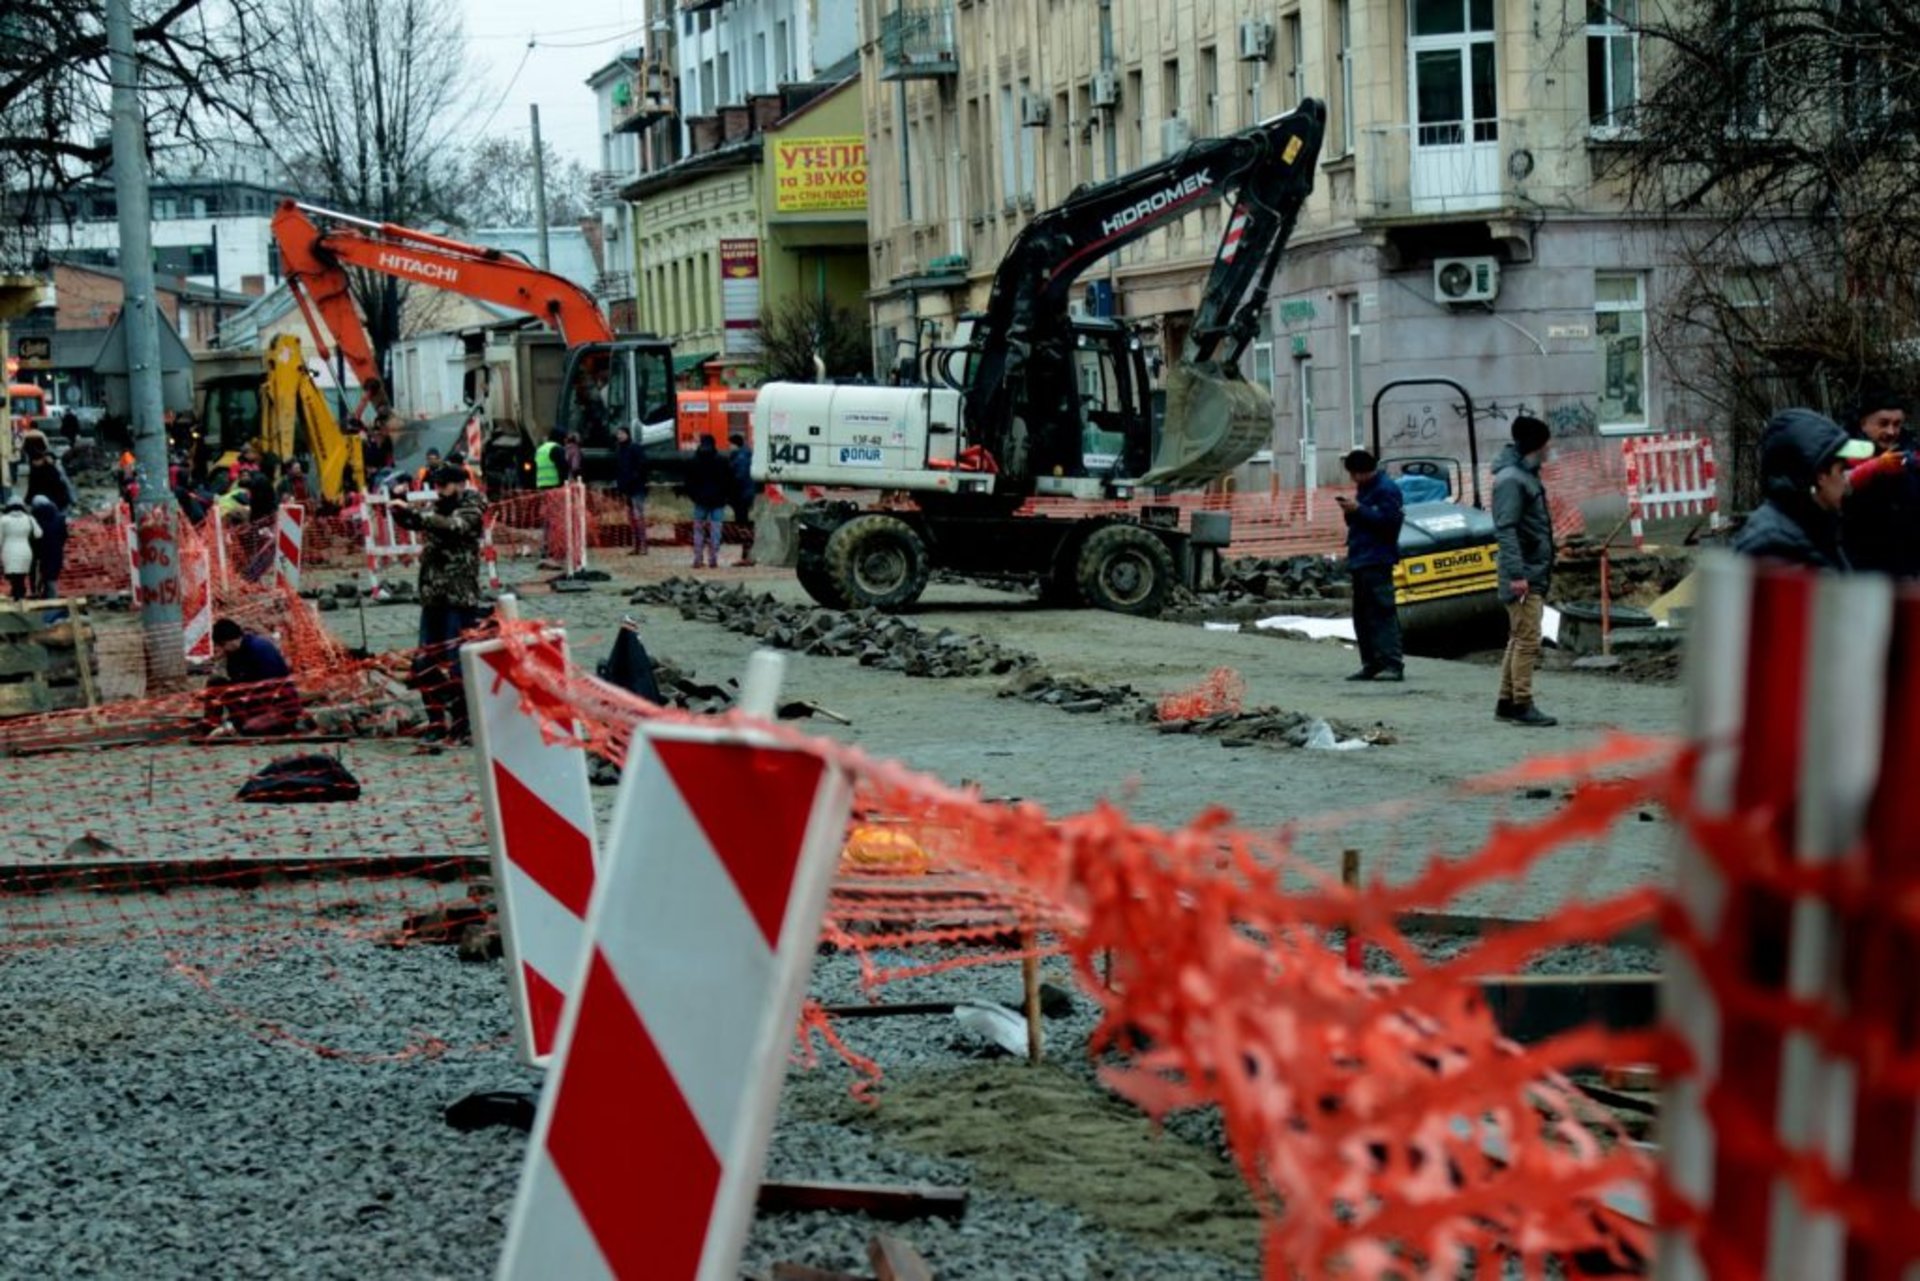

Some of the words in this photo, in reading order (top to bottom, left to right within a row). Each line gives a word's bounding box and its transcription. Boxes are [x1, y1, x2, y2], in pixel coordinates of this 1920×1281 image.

[780, 177, 797, 188] та
[804, 169, 866, 188] ЗВУКО
[379, 252, 458, 282] HITACHI
[769, 443, 810, 464] 140
[768, 465, 782, 474] W
[1433, 552, 1482, 569] BOMAG
